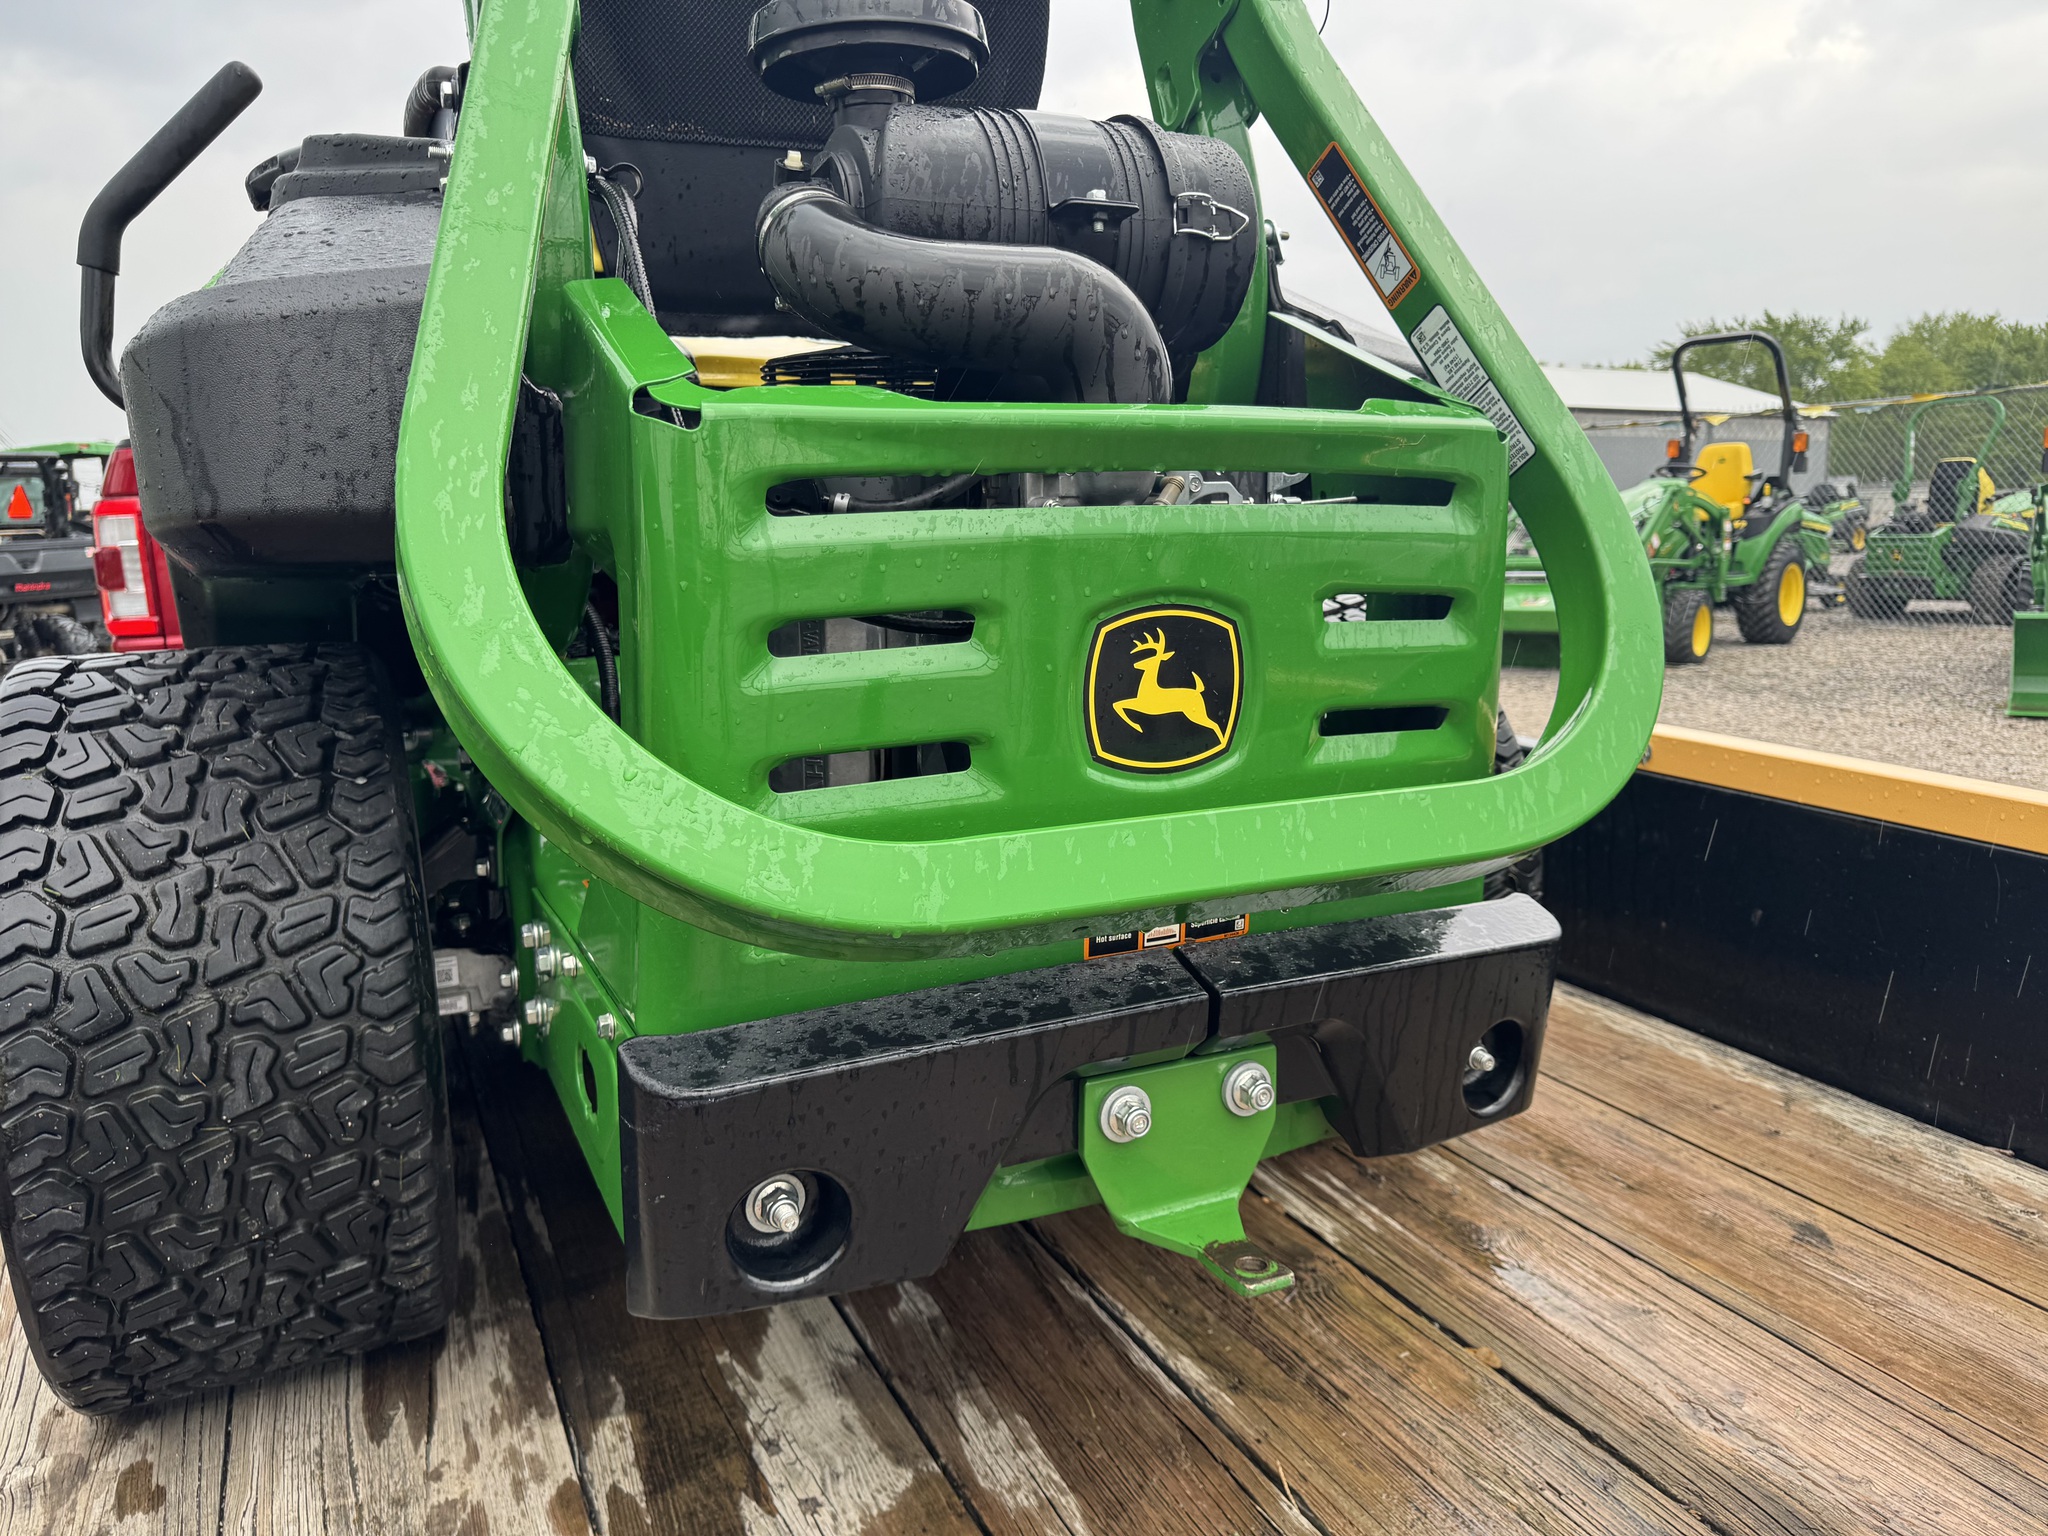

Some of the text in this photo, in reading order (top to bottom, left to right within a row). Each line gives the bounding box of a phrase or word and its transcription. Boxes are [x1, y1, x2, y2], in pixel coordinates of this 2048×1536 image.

[1361, 226, 1388, 262] AVOID CRUSHING
[1387, 274, 1413, 308] WARNING
[1096, 932, 1132, 944] Hot surface
